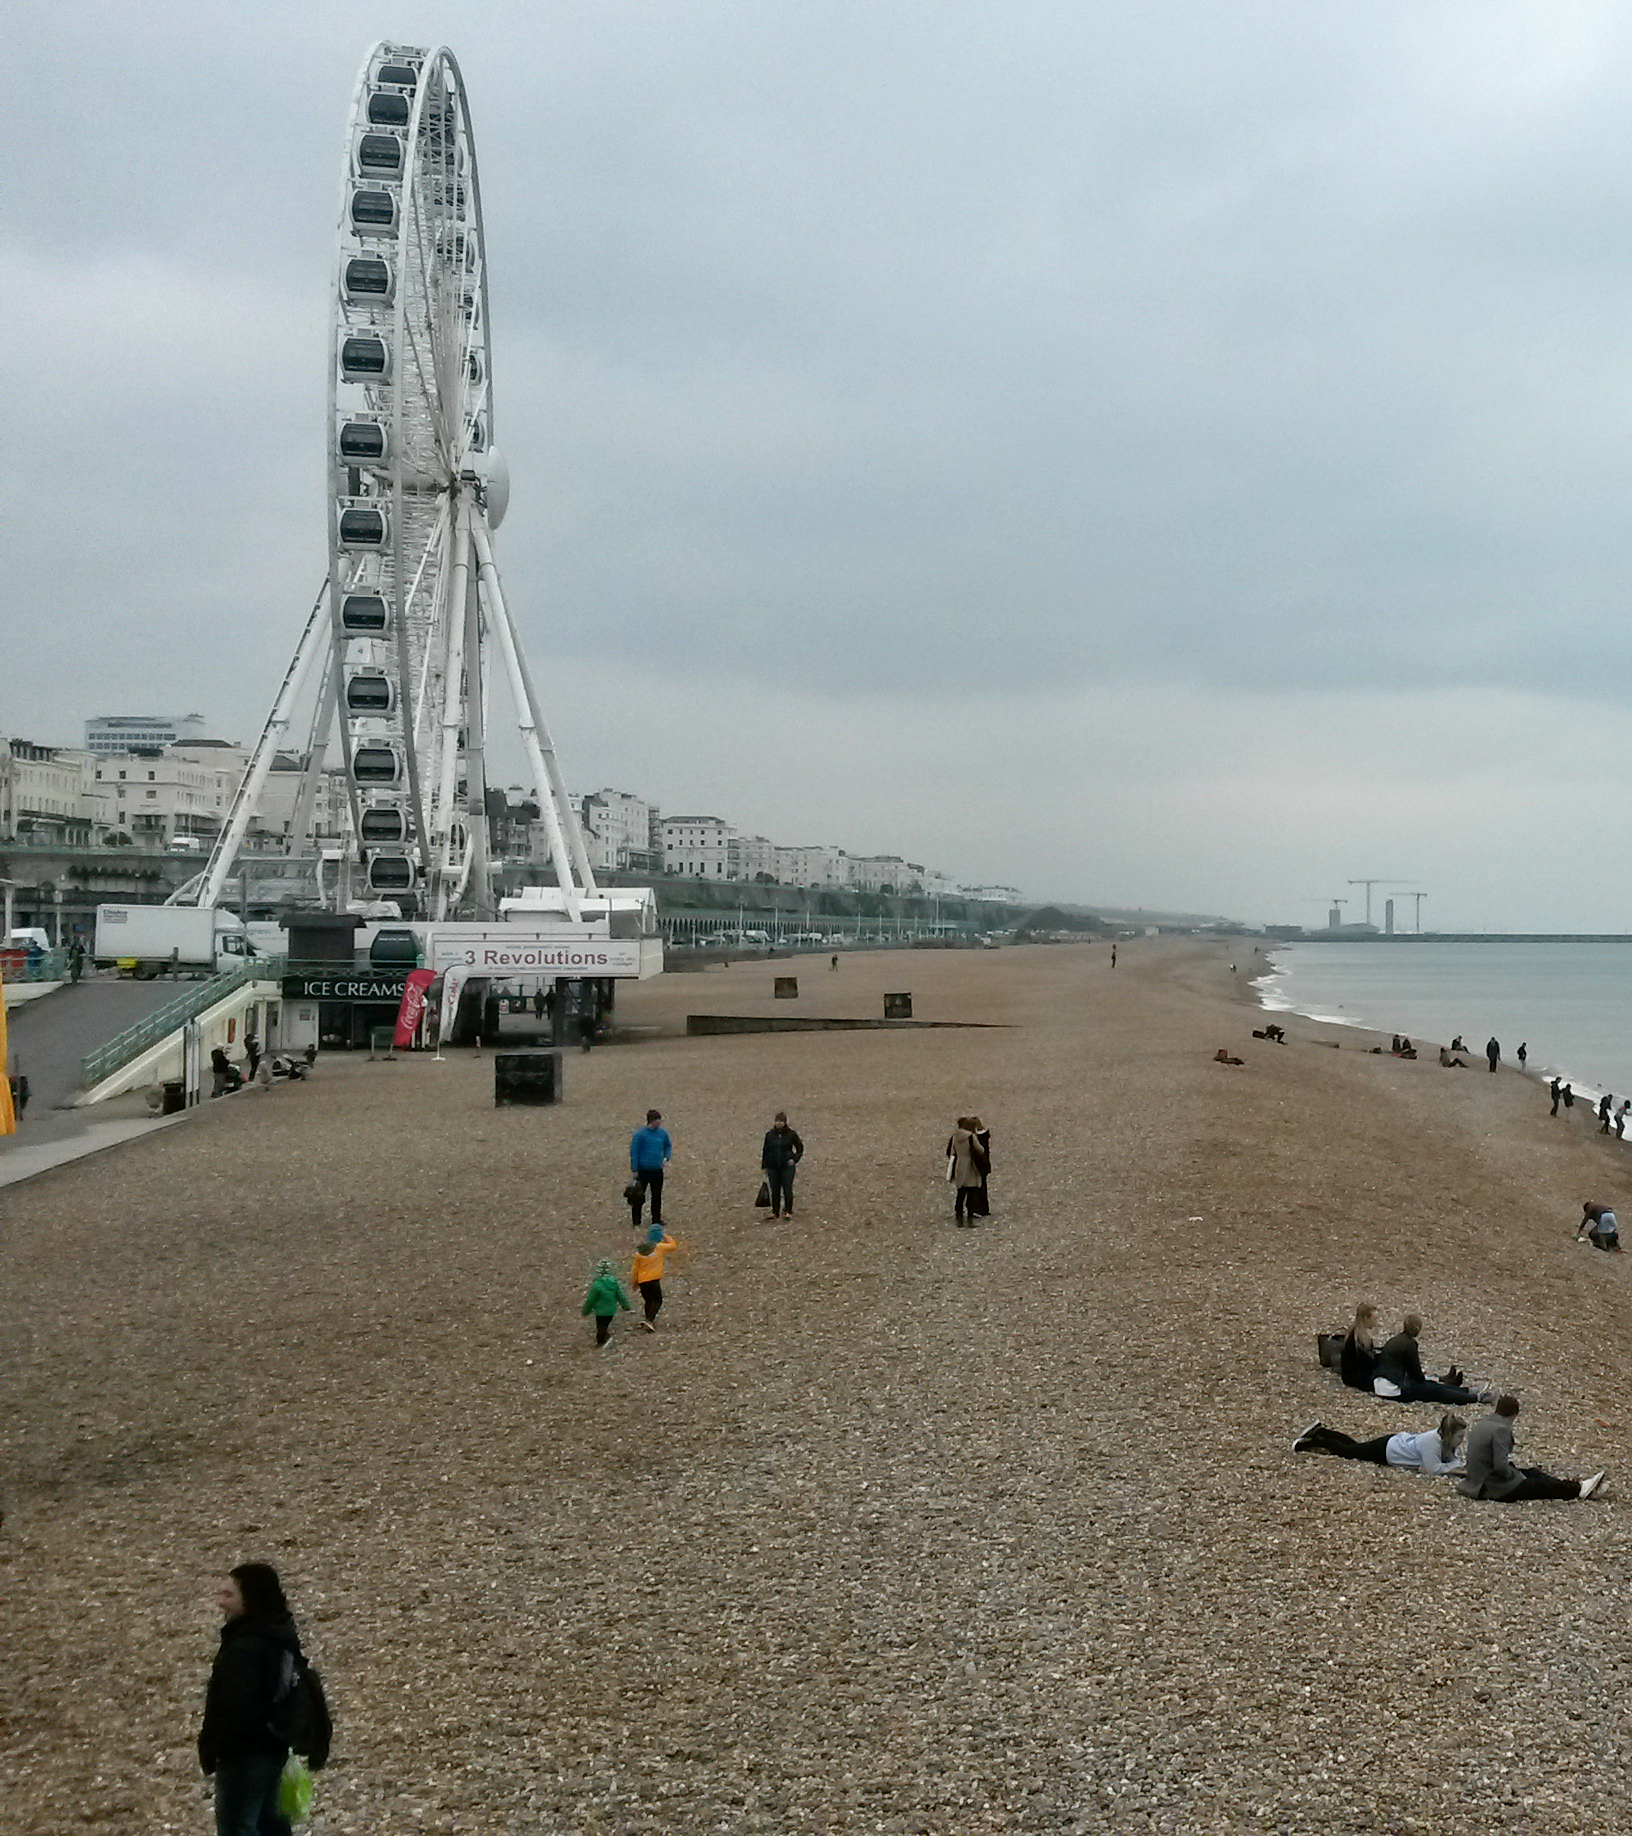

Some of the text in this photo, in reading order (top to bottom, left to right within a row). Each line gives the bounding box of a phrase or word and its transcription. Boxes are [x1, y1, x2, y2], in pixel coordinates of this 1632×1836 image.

[465, 950, 476, 965] 3
[484, 950, 608, 965] Revolutions
[304, 981, 406, 997] ICE CREAMS
